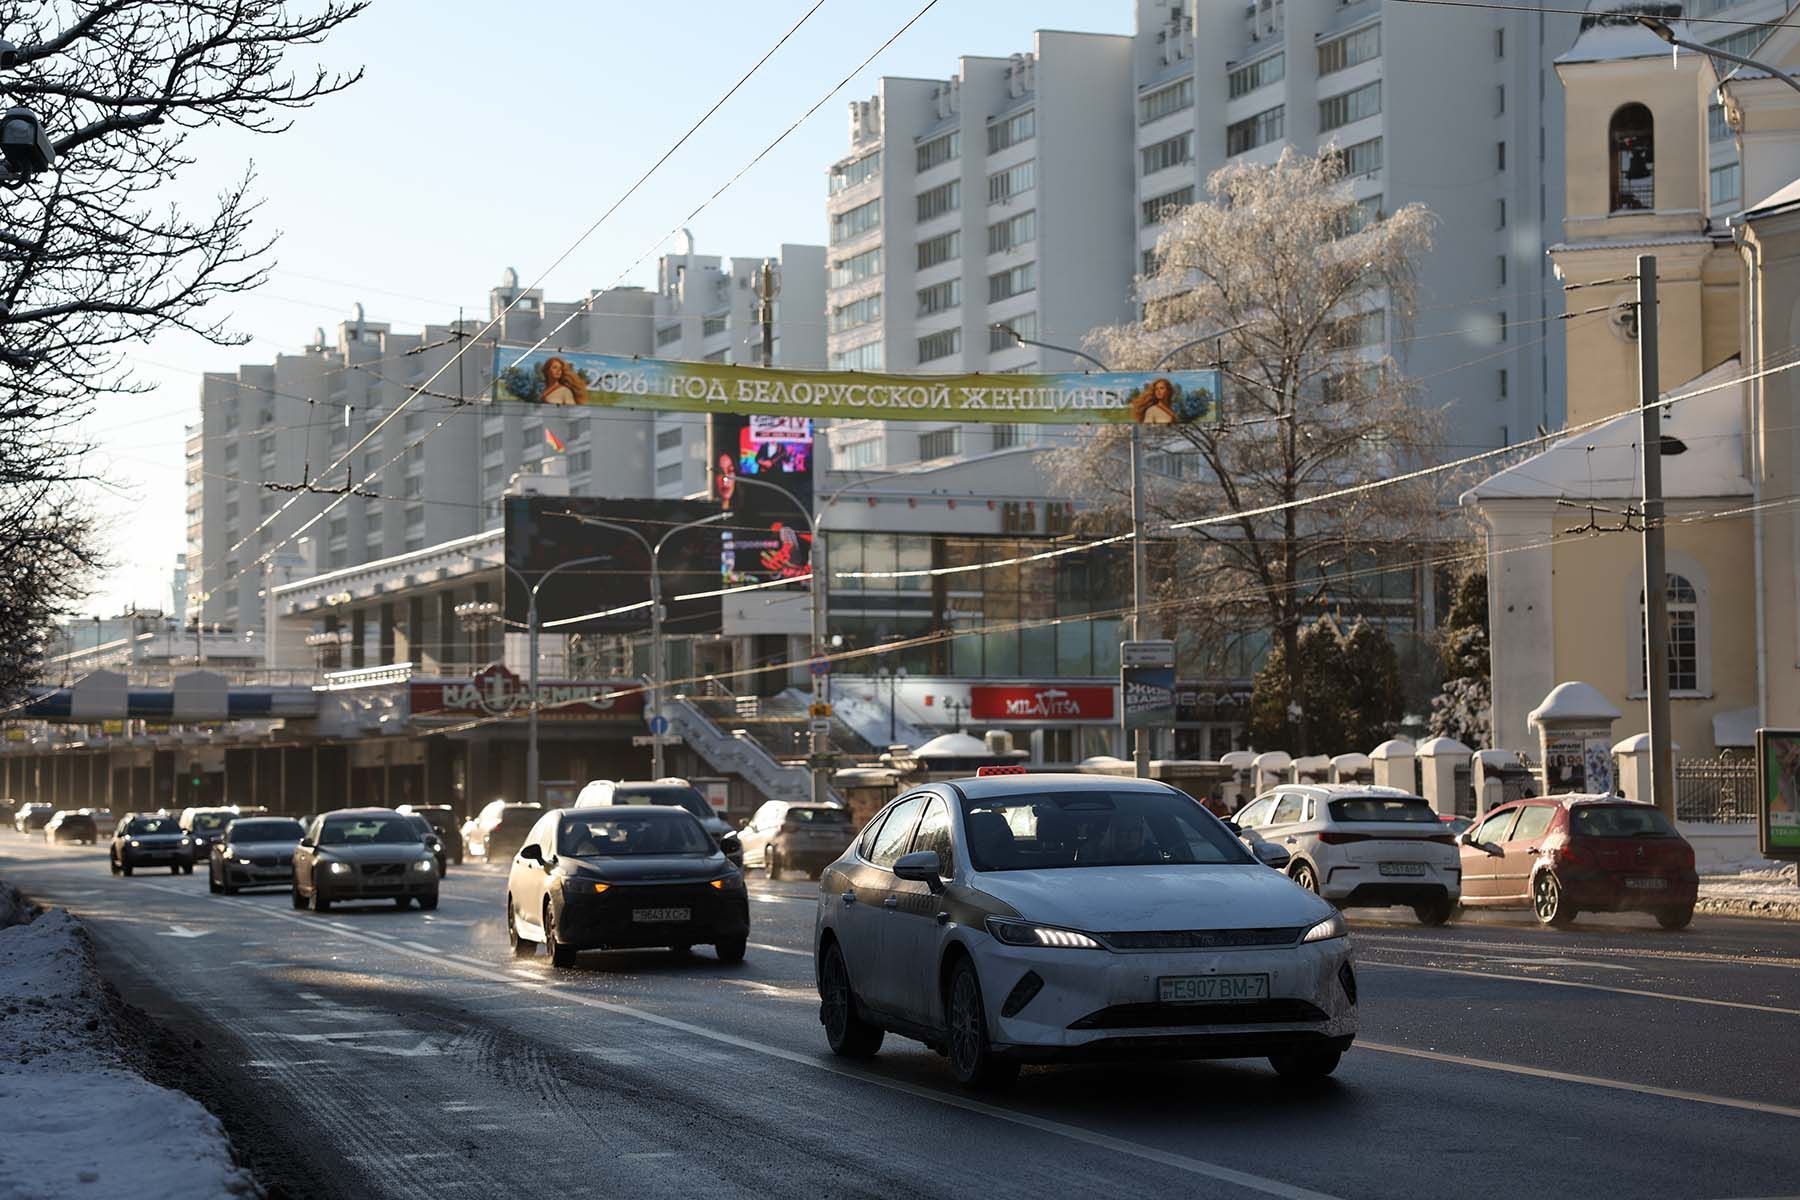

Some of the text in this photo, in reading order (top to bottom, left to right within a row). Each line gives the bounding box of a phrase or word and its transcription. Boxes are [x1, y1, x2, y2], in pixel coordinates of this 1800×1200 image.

[587, 367, 1126, 412] 2026 ГОД БЕЛОРУССКОЙ ЖЕНЩИНЫ
[1006, 692, 1080, 718] MILAVITSA
[1175, 979, 1216, 999] E907
[1219, 977, 1264, 998] BM-7
